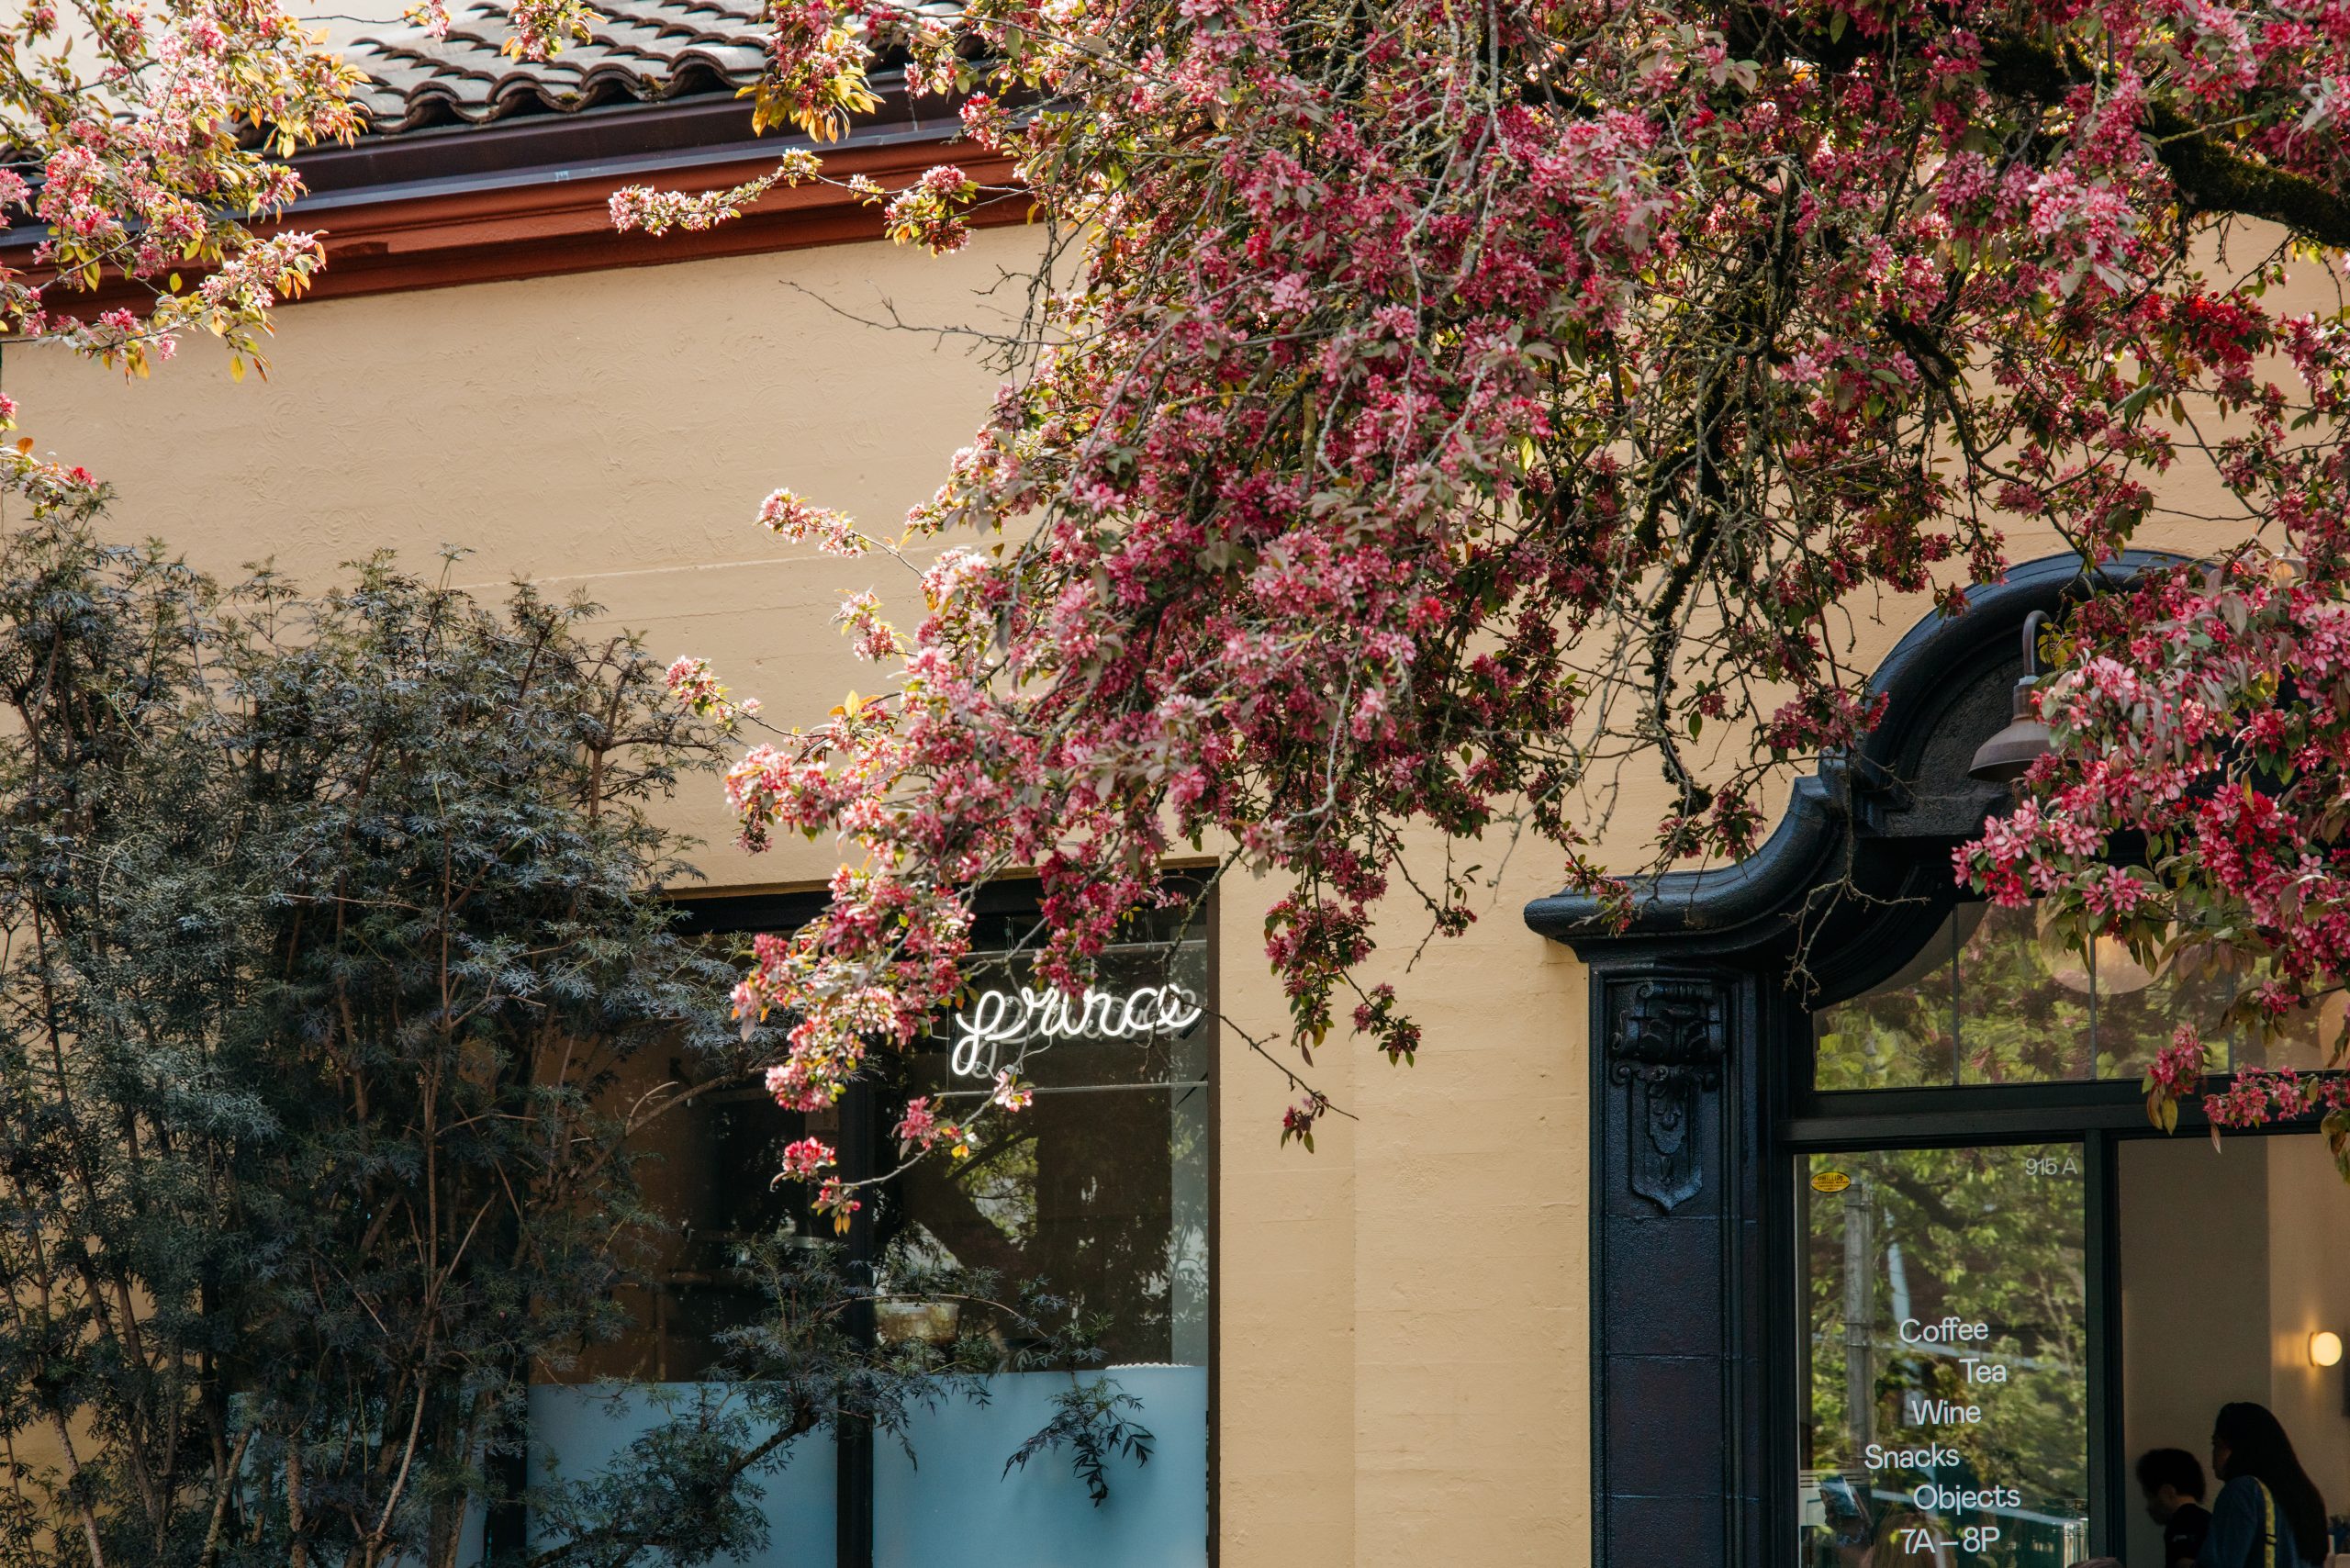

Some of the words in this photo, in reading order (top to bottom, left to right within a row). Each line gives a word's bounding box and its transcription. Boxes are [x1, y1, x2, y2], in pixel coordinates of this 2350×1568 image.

[2025, 1158, 2058, 1176] 915
[2062, 1157, 2078, 1175] A
[1899, 1316, 1989, 1343] Coffee
[1959, 1358, 2007, 1383] Tea
[1911, 1399, 1982, 1426] Wine
[1864, 1442, 1960, 1470] Snacks
[1913, 1484, 2021, 1516] Objects
